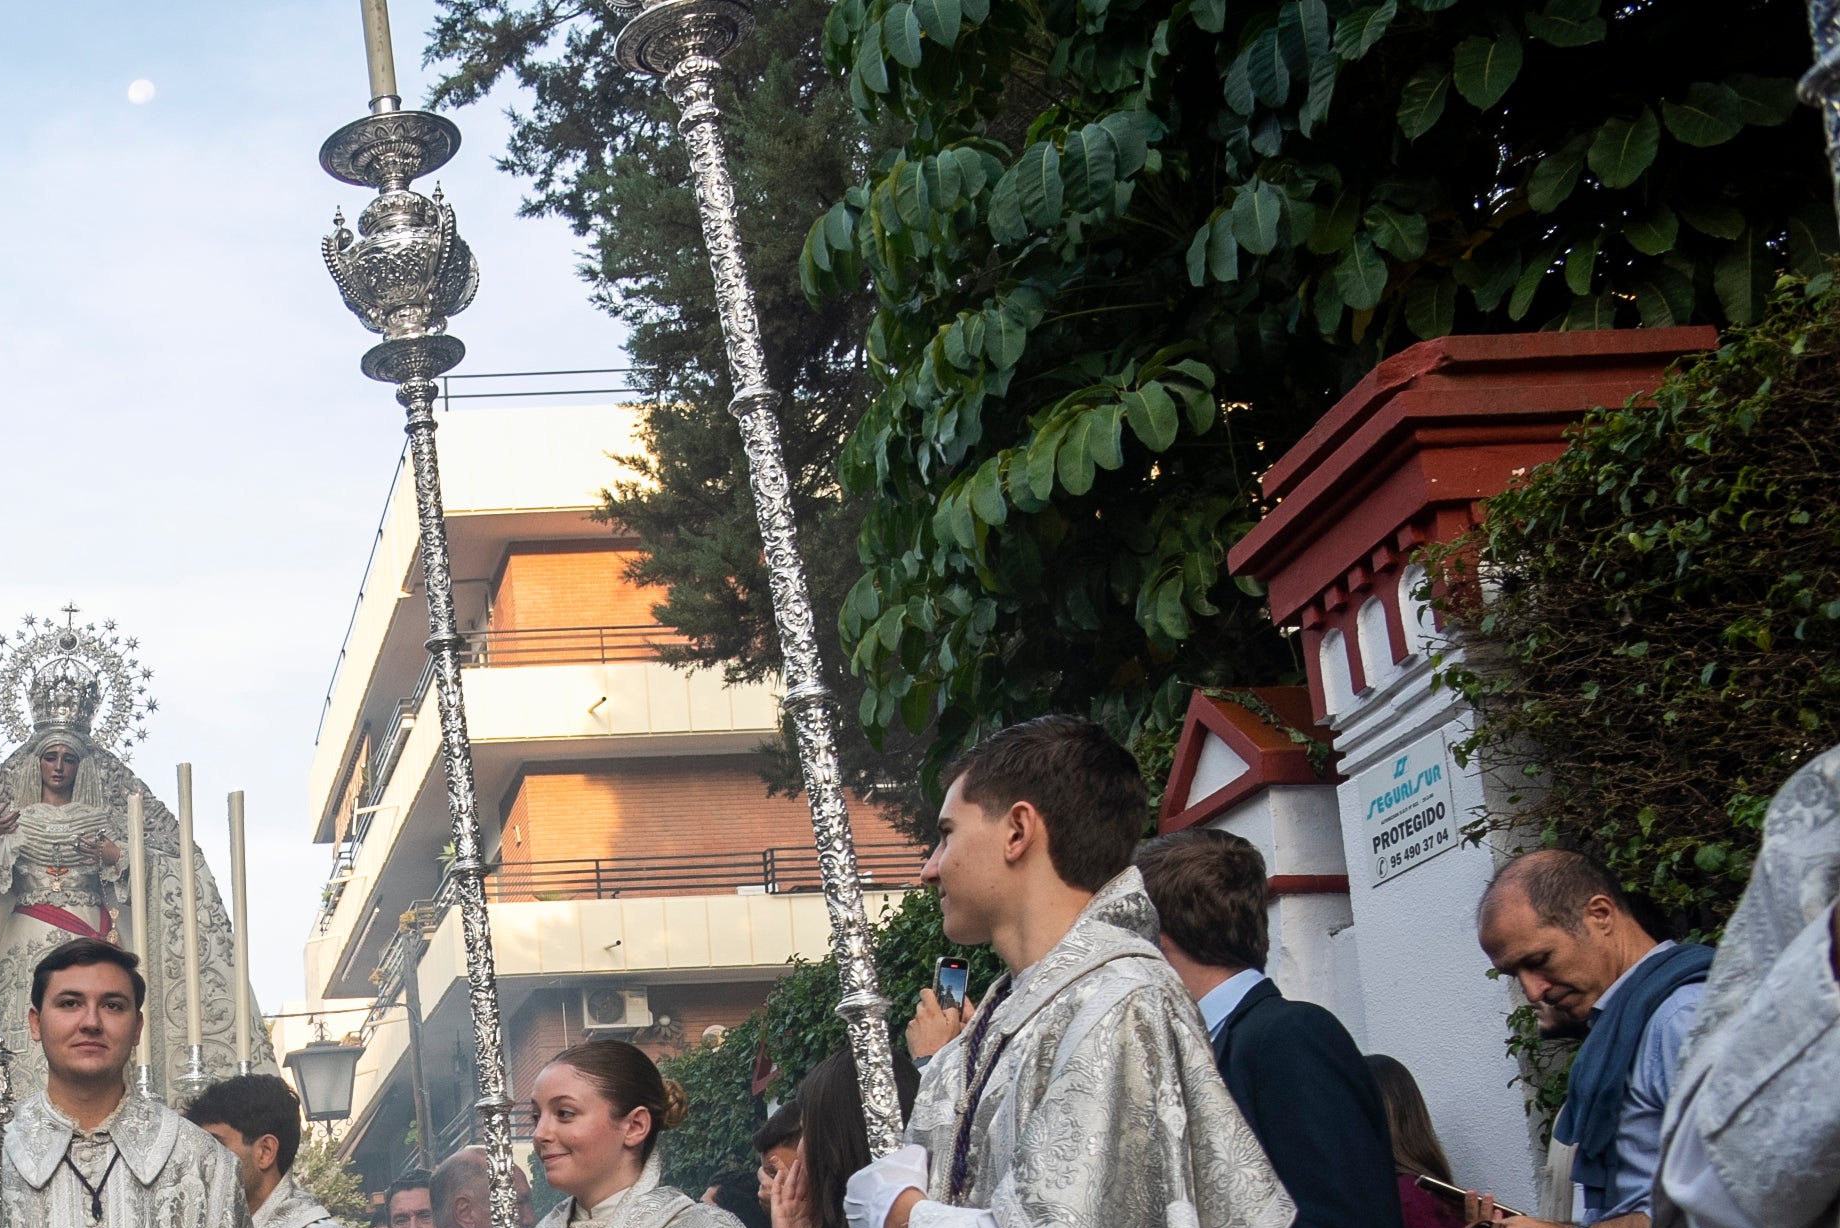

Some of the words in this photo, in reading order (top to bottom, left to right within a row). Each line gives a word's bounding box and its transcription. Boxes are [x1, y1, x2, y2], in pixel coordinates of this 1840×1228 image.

[1366, 764, 1442, 821] SEGURISUR
[1372, 801, 1445, 854] PROTEGIDO
[1390, 852, 1402, 868] 95
[1403, 842, 1421, 861] 490
[1422, 835, 1434, 852] 37
[1436, 827, 1449, 845] 04
